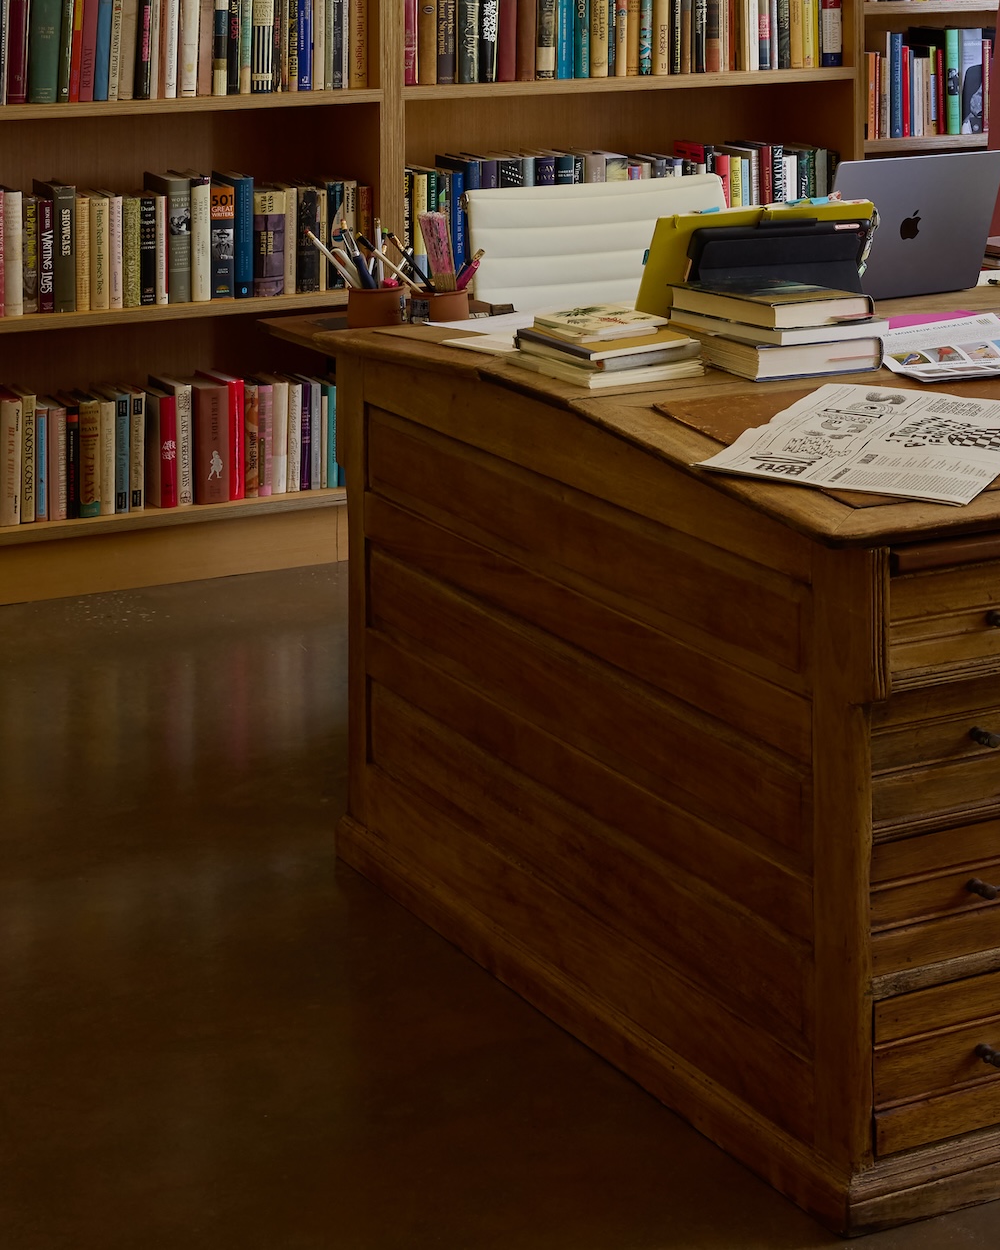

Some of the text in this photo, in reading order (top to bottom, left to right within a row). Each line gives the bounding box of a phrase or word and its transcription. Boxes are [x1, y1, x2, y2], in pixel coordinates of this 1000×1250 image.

[231, 17, 239, 39] IDEAS
[438, 20, 447, 55] Stopping
[355, 39, 364, 70] Piggies
[212, 195, 233, 205] 501
[26, 204, 36, 269] The Party's Over Now
[41, 229, 53, 270] WRITING
[61, 208, 71, 256] SHOWCASE
[41, 272, 54, 293] LIVES
[211, 397, 219, 441] EURIPIDES
[25, 410, 33, 501] THE GNOSTIC GOSPELS
[181, 415, 190, 487] LAKE WOBEGON DAYS
[7, 457, 15, 499] THEATER
[85, 454, 95, 503] 7 PLAYS
